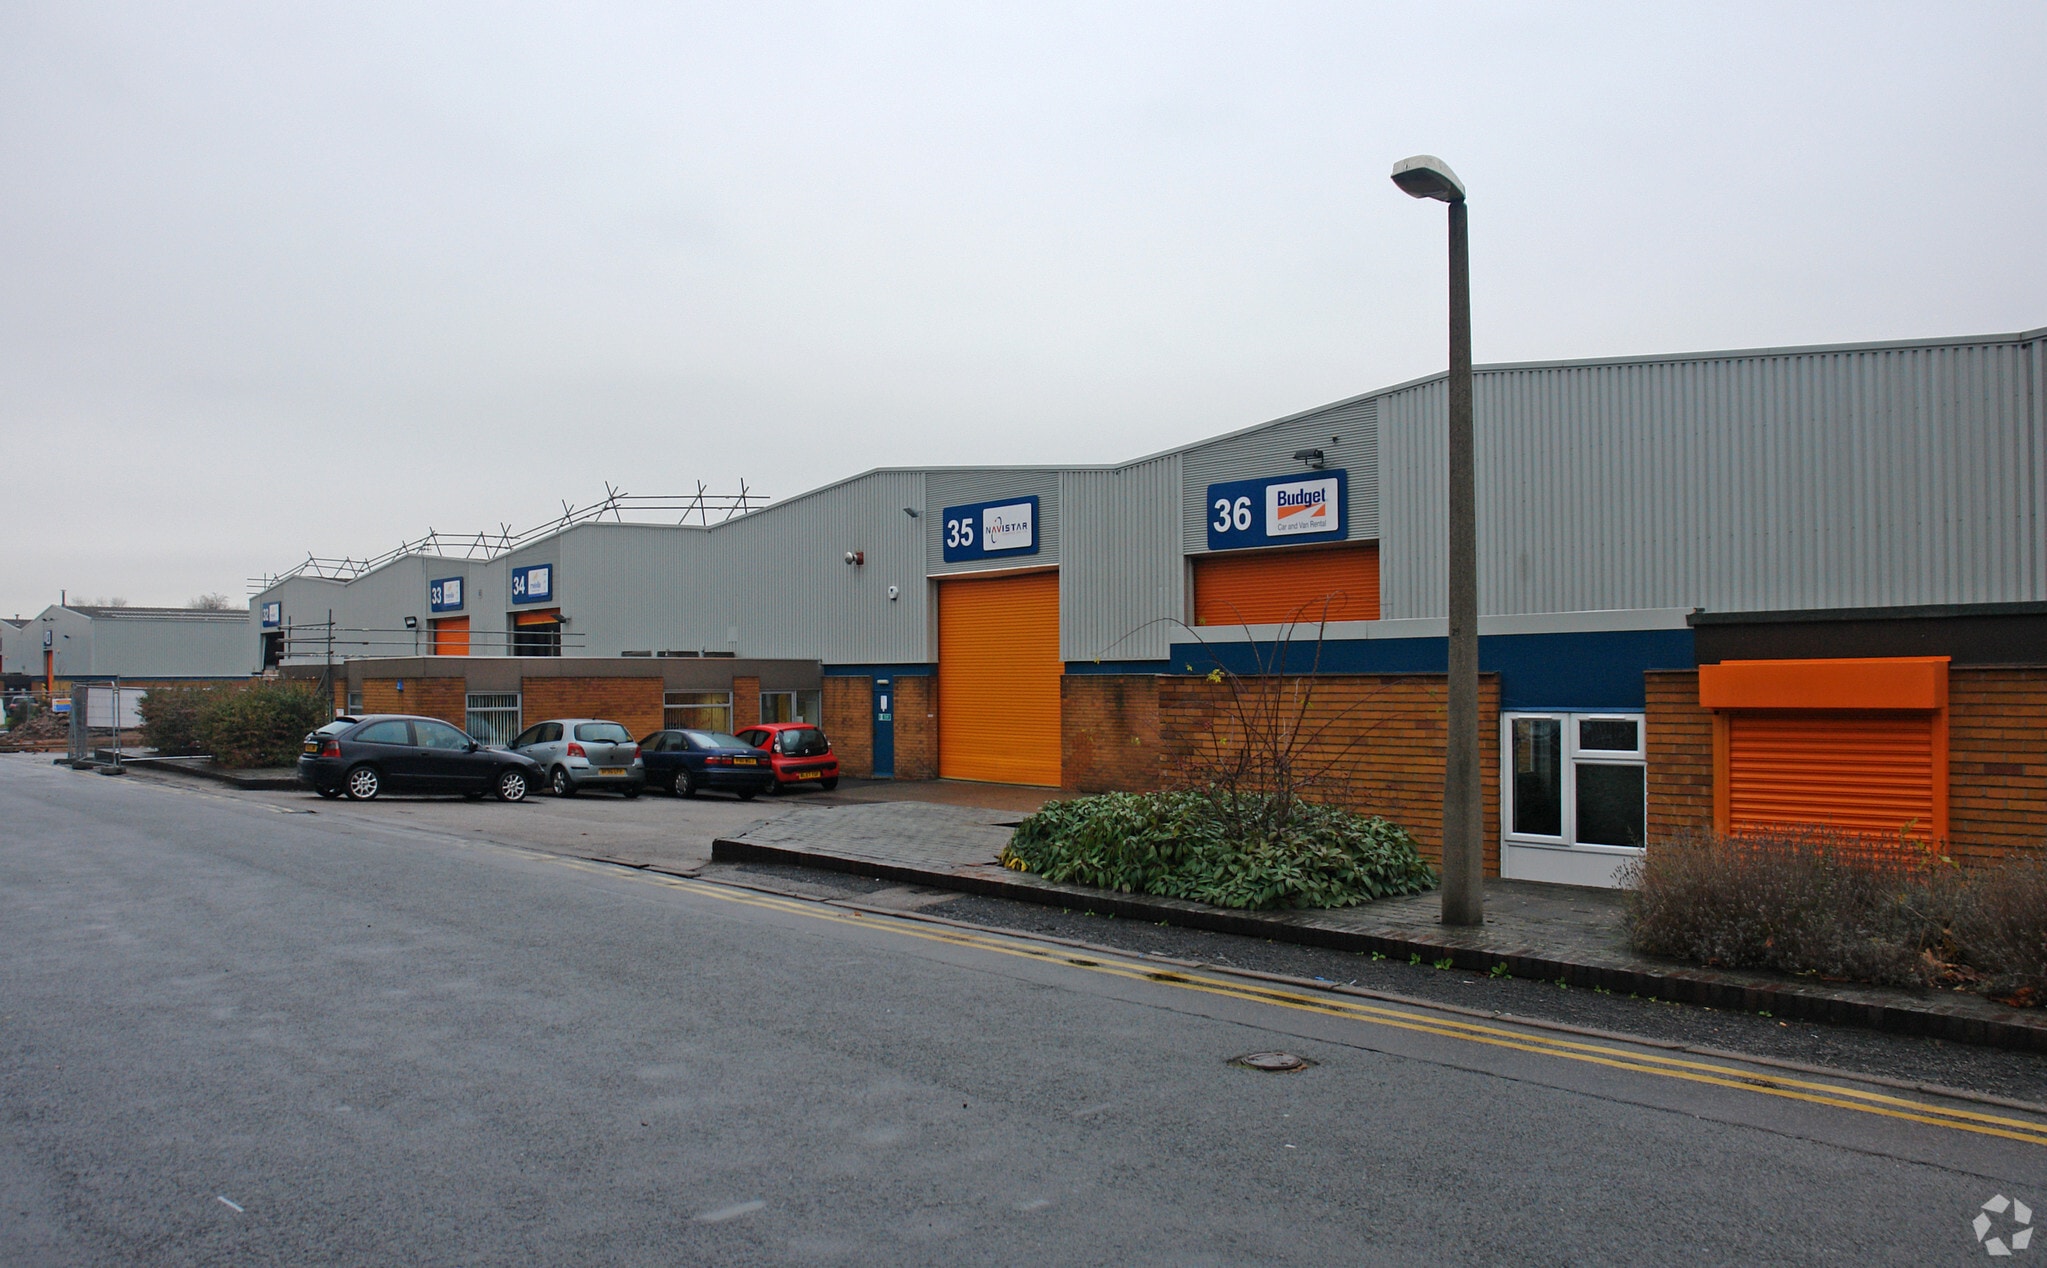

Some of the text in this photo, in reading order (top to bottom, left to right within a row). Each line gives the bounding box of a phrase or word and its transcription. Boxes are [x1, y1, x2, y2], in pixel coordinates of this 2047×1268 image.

[1278, 488, 1326, 507] Budget
[1213, 496, 1252, 532] 36
[947, 518, 974, 548] 35
[986, 522, 1028, 534] NAVISTAR
[1278, 523, 1288, 531] Car
[1288, 522, 1298, 530] and
[1299, 520, 1309, 529] Van
[513, 576, 525, 595] 34
[432, 587, 442, 604] 33
